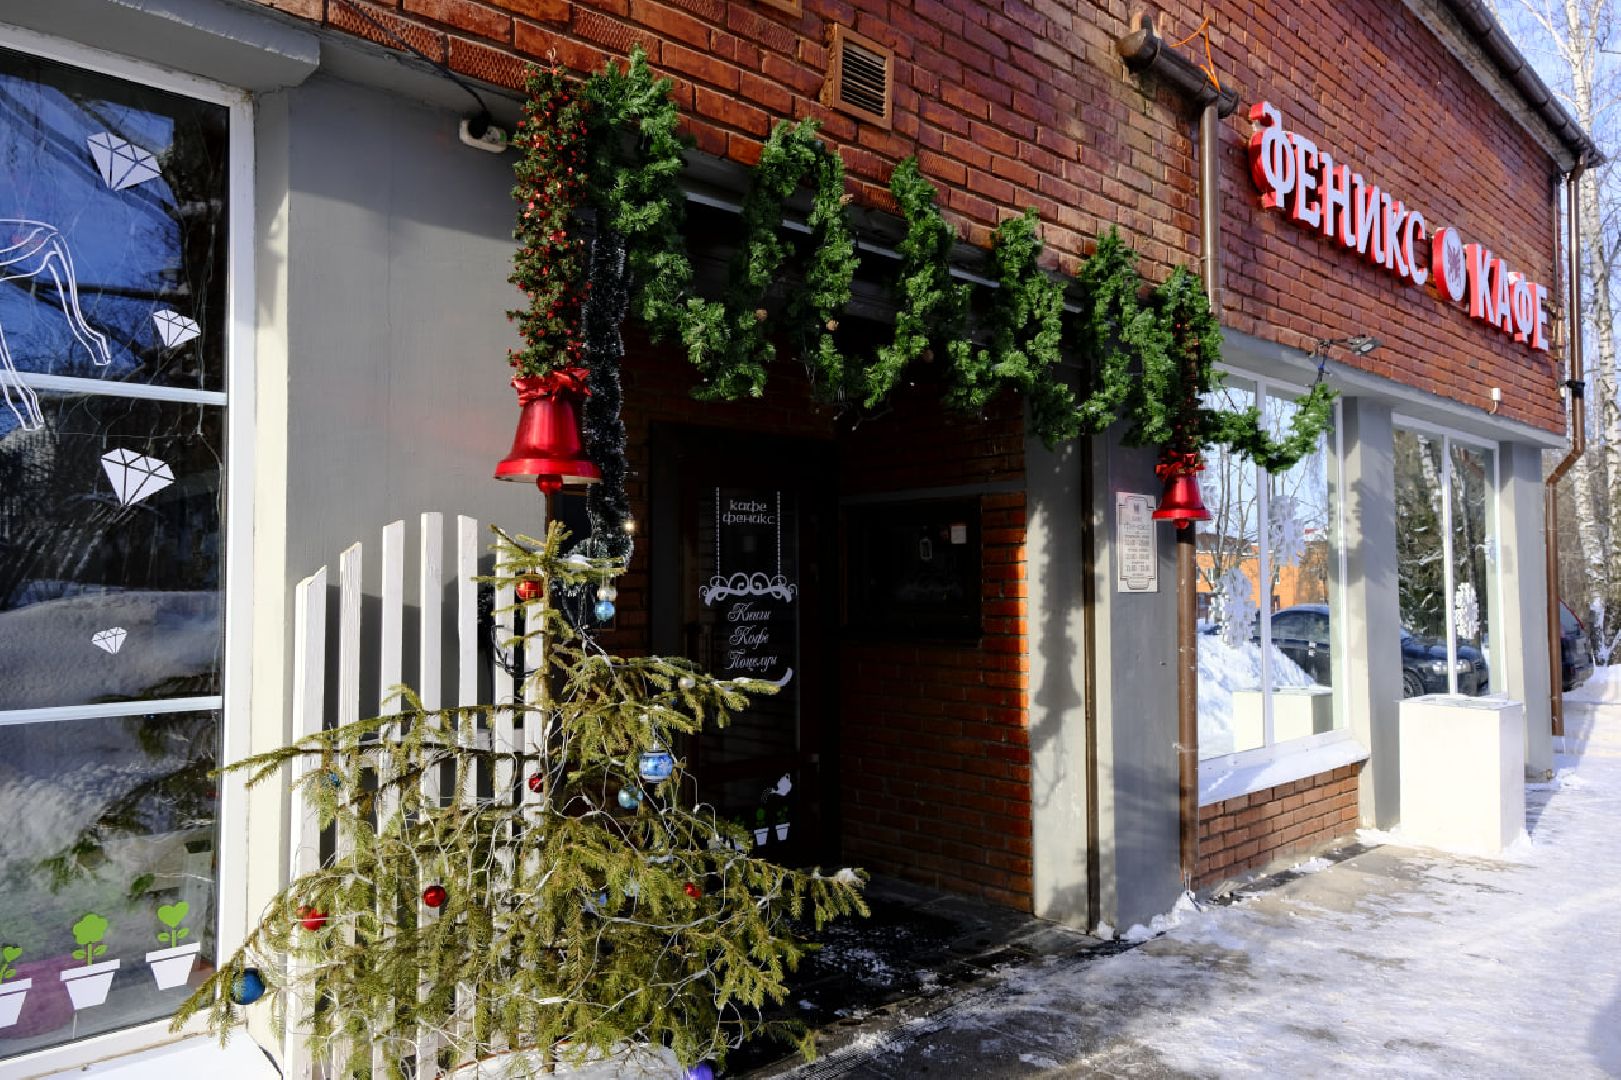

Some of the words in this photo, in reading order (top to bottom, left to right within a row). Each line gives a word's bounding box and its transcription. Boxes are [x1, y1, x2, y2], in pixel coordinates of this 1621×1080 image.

[1249, 102, 1429, 284] ФЕНИКС
[1465, 242, 1549, 351] КАФЕ
[729, 625, 770, 650] Кофе
